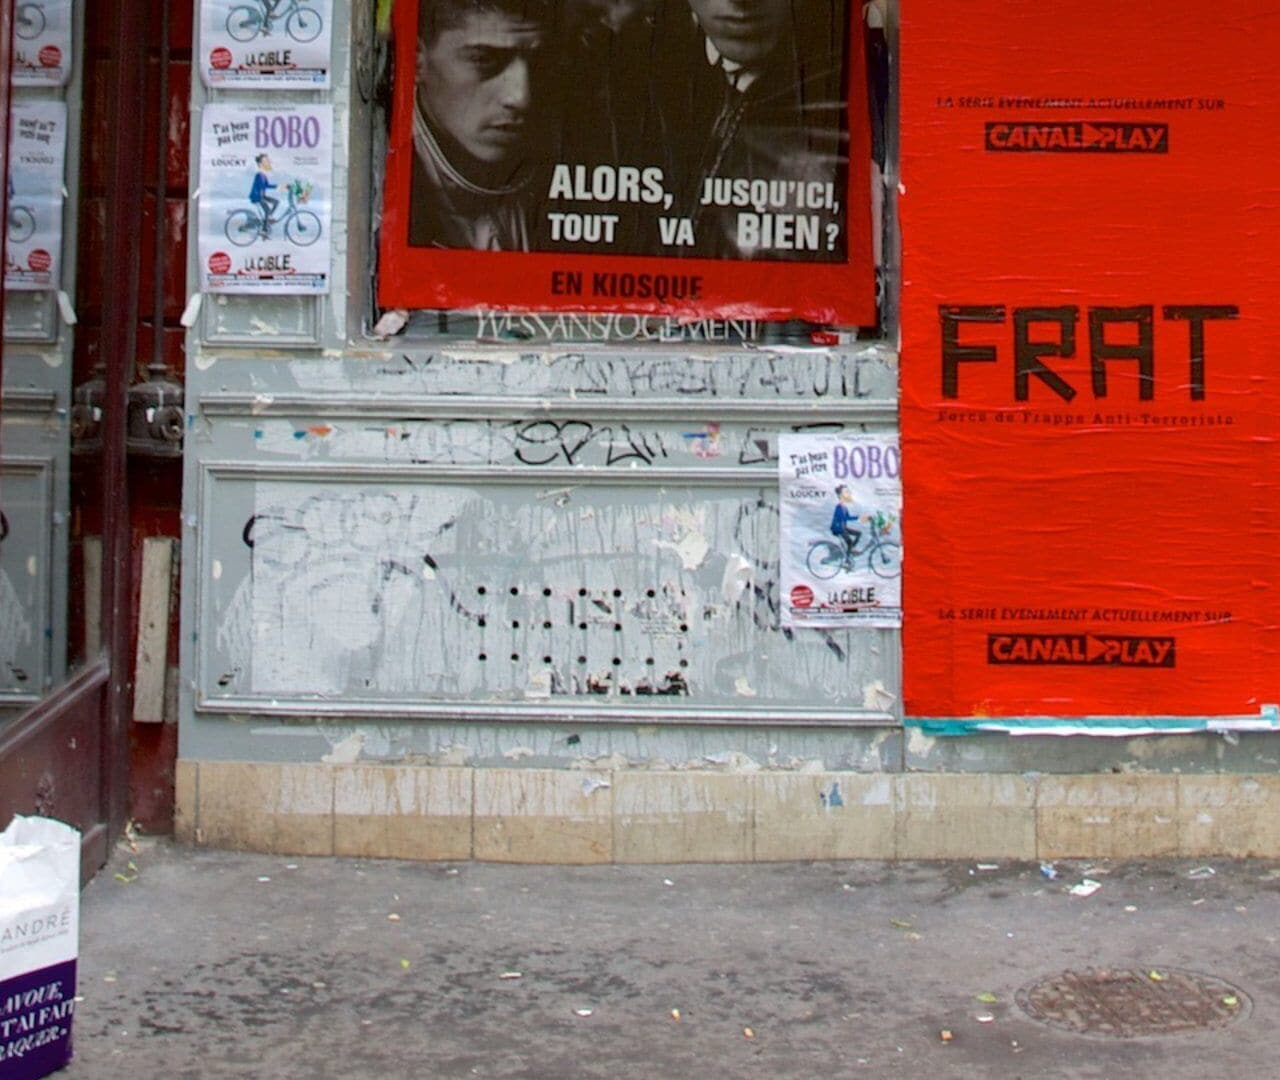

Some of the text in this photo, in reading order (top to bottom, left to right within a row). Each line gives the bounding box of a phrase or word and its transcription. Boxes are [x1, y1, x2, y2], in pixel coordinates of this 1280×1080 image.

[255, 115, 320, 148] BOBO
[549, 165, 839, 213] ALORS, JUSQU'ICI,
[548, 213, 838, 251] TOUT VA BIEN ?
[552, 272, 703, 303] EN KIOSQUE
[938, 304, 1240, 402] FRAT
[833, 445, 899, 479] BOBO
[840, 587, 875, 605] CIBLE
[1, 908, 70, 945] ANDRÉ
